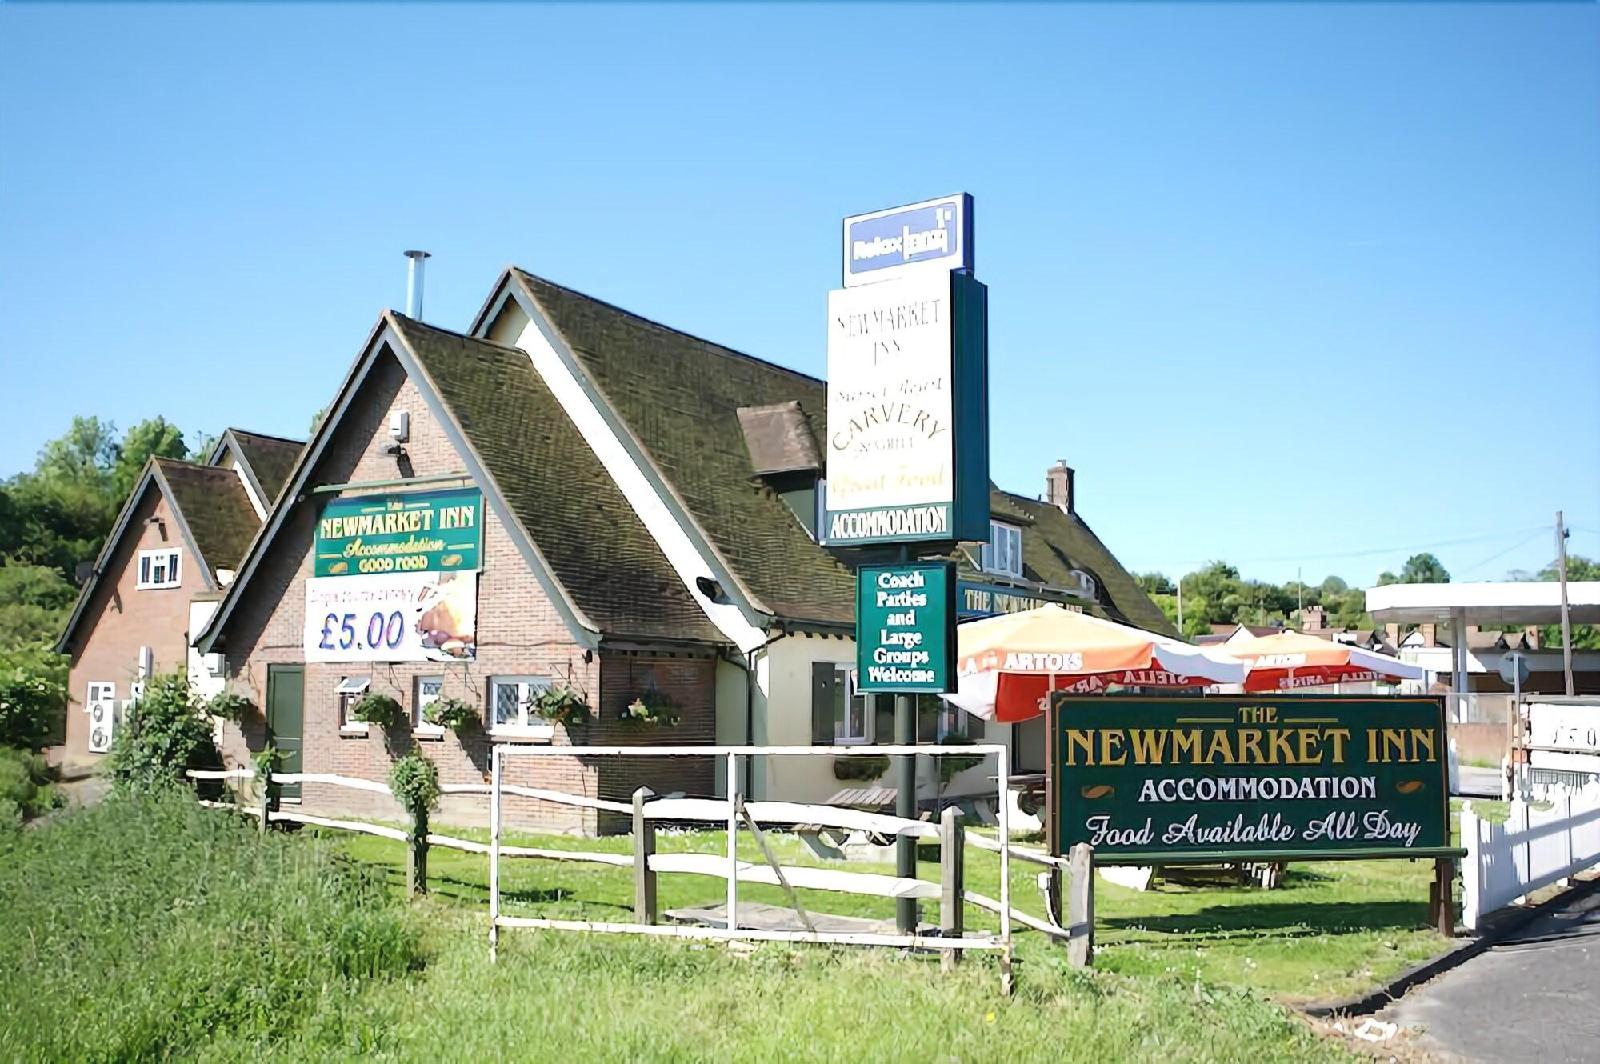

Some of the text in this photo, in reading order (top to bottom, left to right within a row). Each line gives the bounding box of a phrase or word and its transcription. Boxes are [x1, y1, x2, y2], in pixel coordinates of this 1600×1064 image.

[832, 402, 947, 451] CARVERY
[320, 505, 475, 539] NEWMARKET INN
[829, 505, 948, 540] ACCOMMODATION
[343, 534, 447, 559] Accommodation
[358, 554, 429, 573] GOOD FOOD
[877, 571, 924, 588] Coach
[877, 590, 927, 607] Parties
[965, 588, 991, 613] THE
[886, 609, 916, 626] and
[319, 610, 405, 650] £5.00
[881, 629, 923, 649] Large
[873, 647, 930, 668] Groups
[1003, 652, 1083, 671] ARTOIS
[868, 666, 935, 683] Welcome
[1238, 705, 1278, 725] THE
[1065, 727, 1437, 766] NEWMARKET INN
[1138, 775, 1377, 803] ACCOMMODATION
[1085, 808, 1422, 848] Food Available All Day
